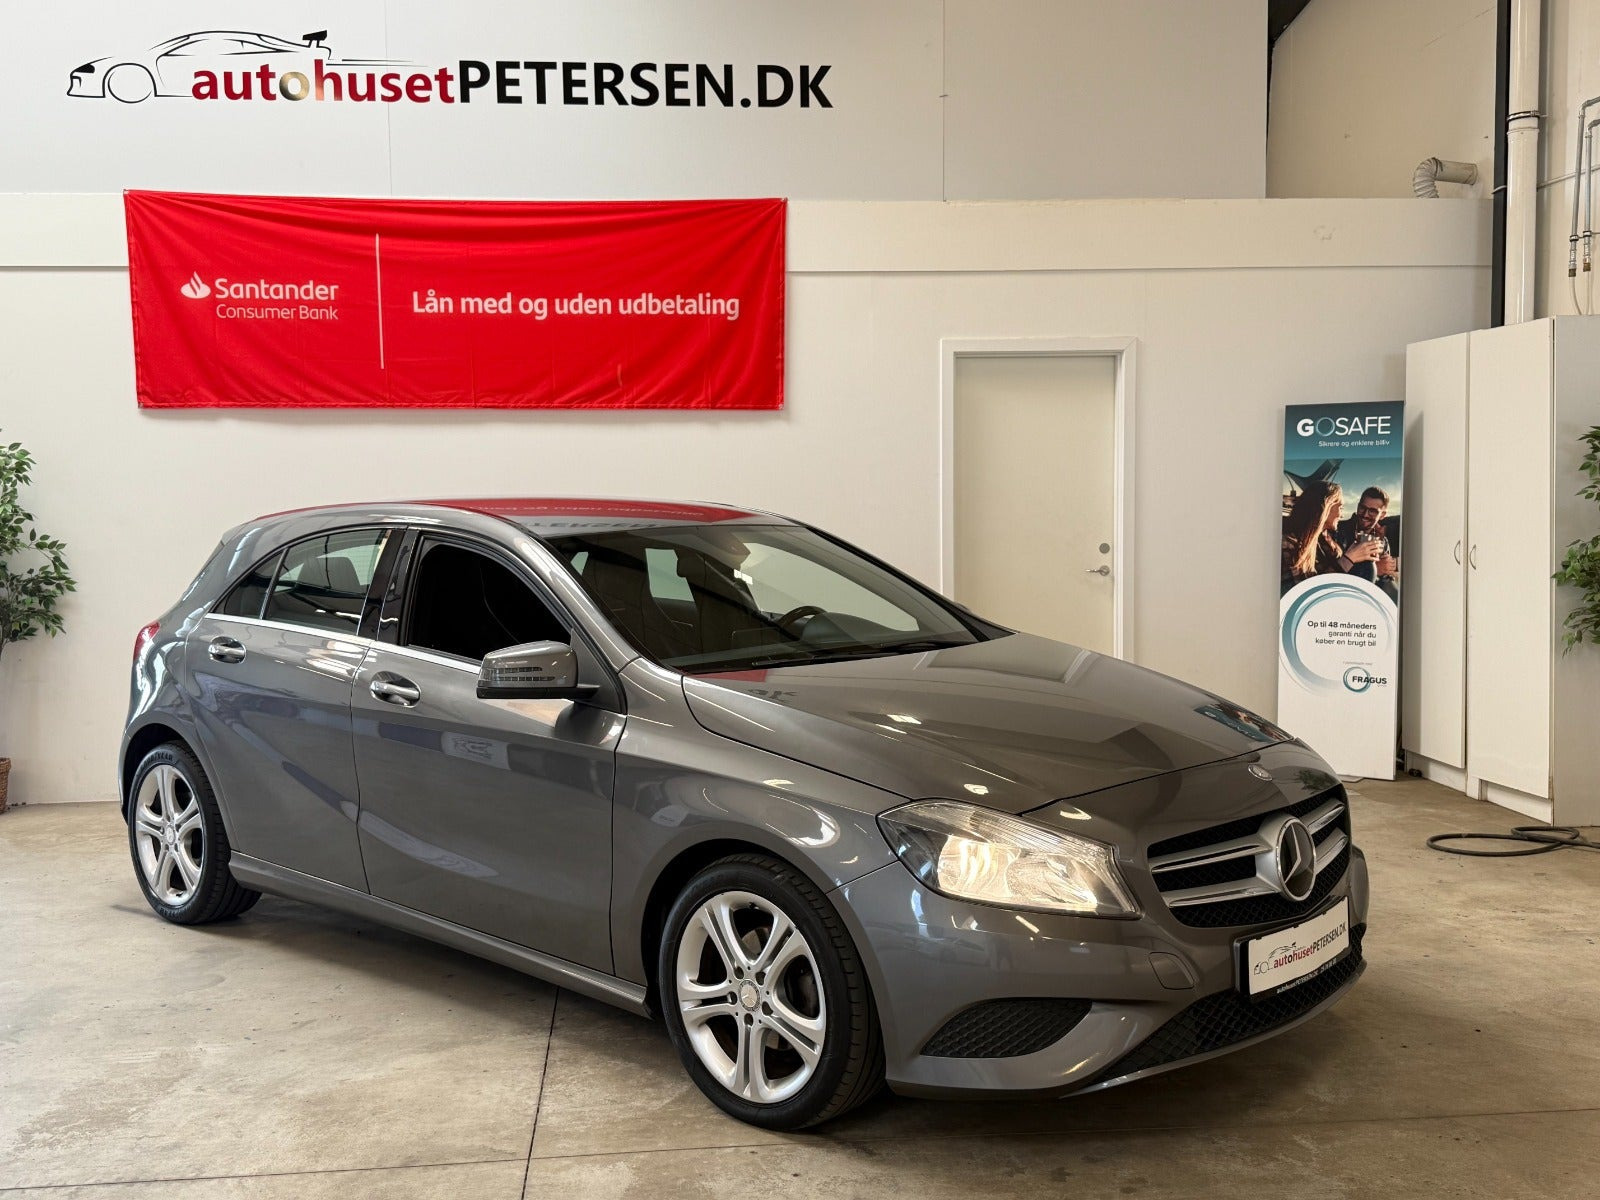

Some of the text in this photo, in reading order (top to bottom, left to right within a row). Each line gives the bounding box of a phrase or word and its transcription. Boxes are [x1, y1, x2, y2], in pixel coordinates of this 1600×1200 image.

[191, 58, 834, 108] autohusetPETERSEN.DK
[214, 278, 339, 301] Santander
[215, 303, 339, 321] Consumer Bank
[412, 289, 740, 321] Lån med og uden udbetaling
[1296, 415, 1392, 437] GOSAFE
[1307, 620, 1319, 628] Op
[1339, 622, 1377, 630] måneders
[1315, 637, 1336, 645] køber
[1347, 639, 1367, 647] brugt
[1352, 675, 1388, 685] FRAGUS
